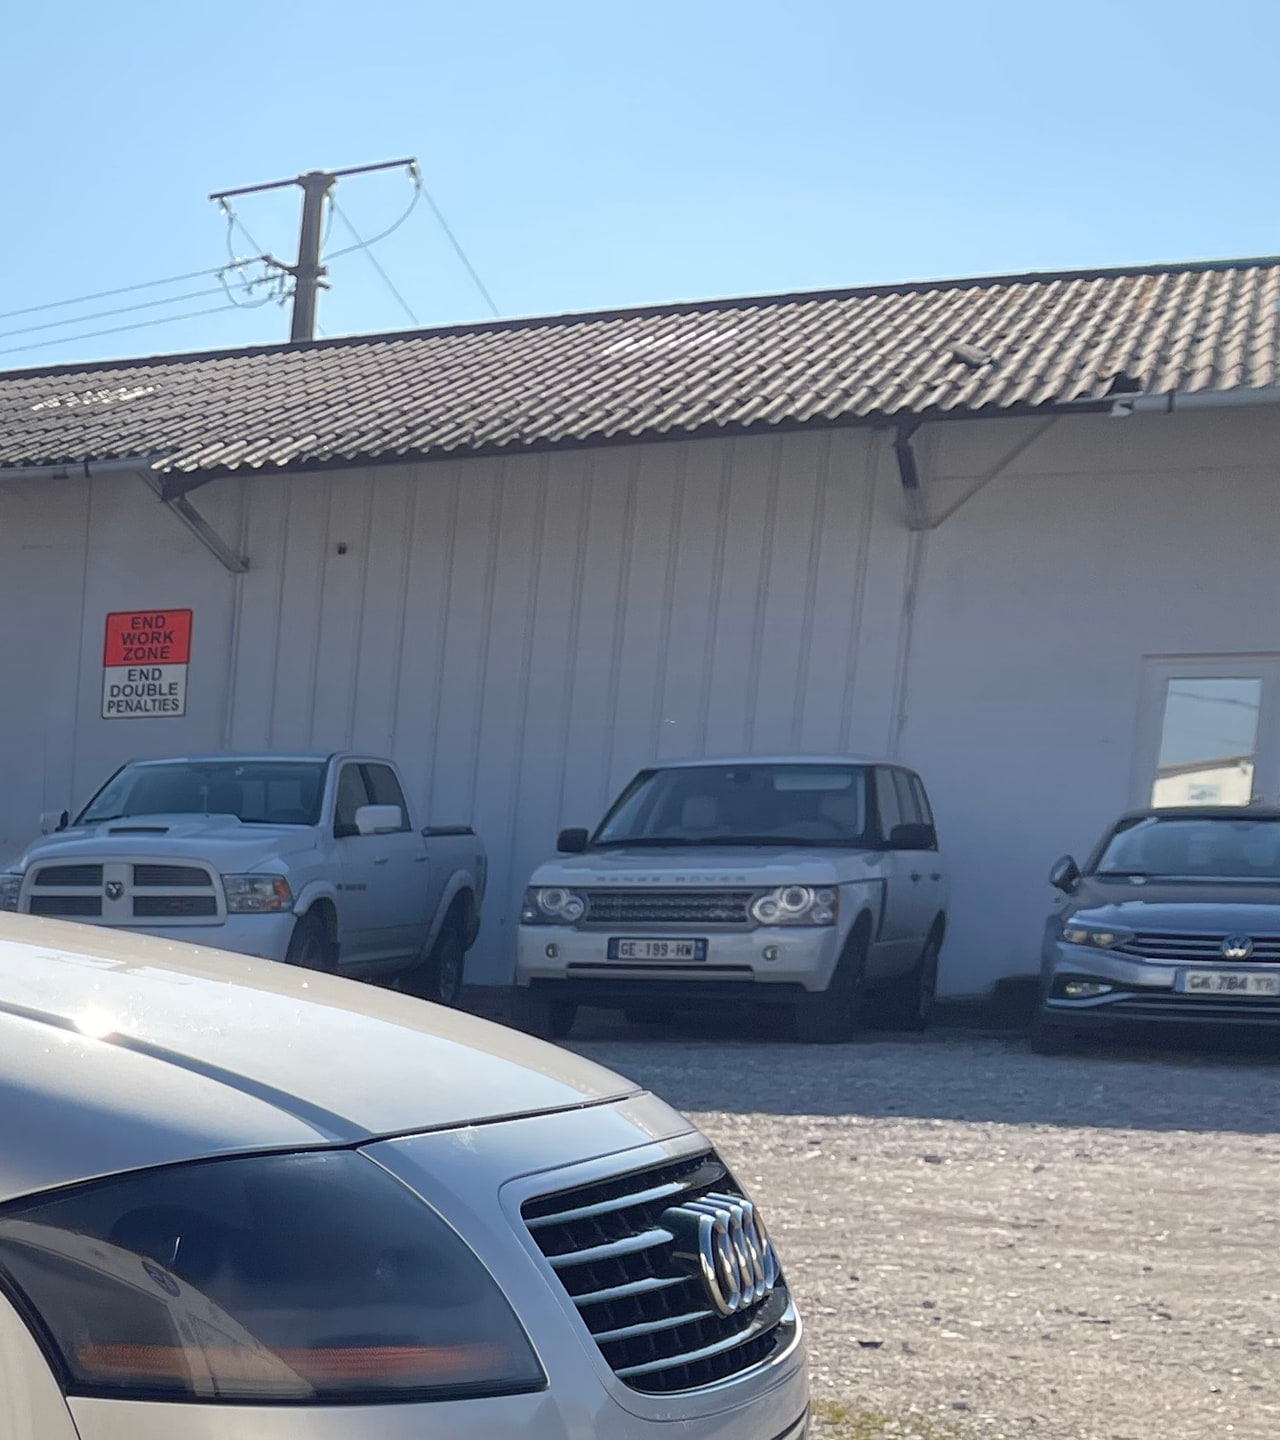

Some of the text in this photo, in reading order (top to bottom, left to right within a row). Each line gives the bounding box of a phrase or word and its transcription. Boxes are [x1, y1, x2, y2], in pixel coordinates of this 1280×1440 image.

[131, 615, 166, 630] END
[121, 630, 174, 645] WORK
[123, 646, 170, 661] ZONE
[127, 668, 162, 682] END
[110, 682, 178, 698] DOUBLE
[107, 698, 179, 713] PENALTIES
